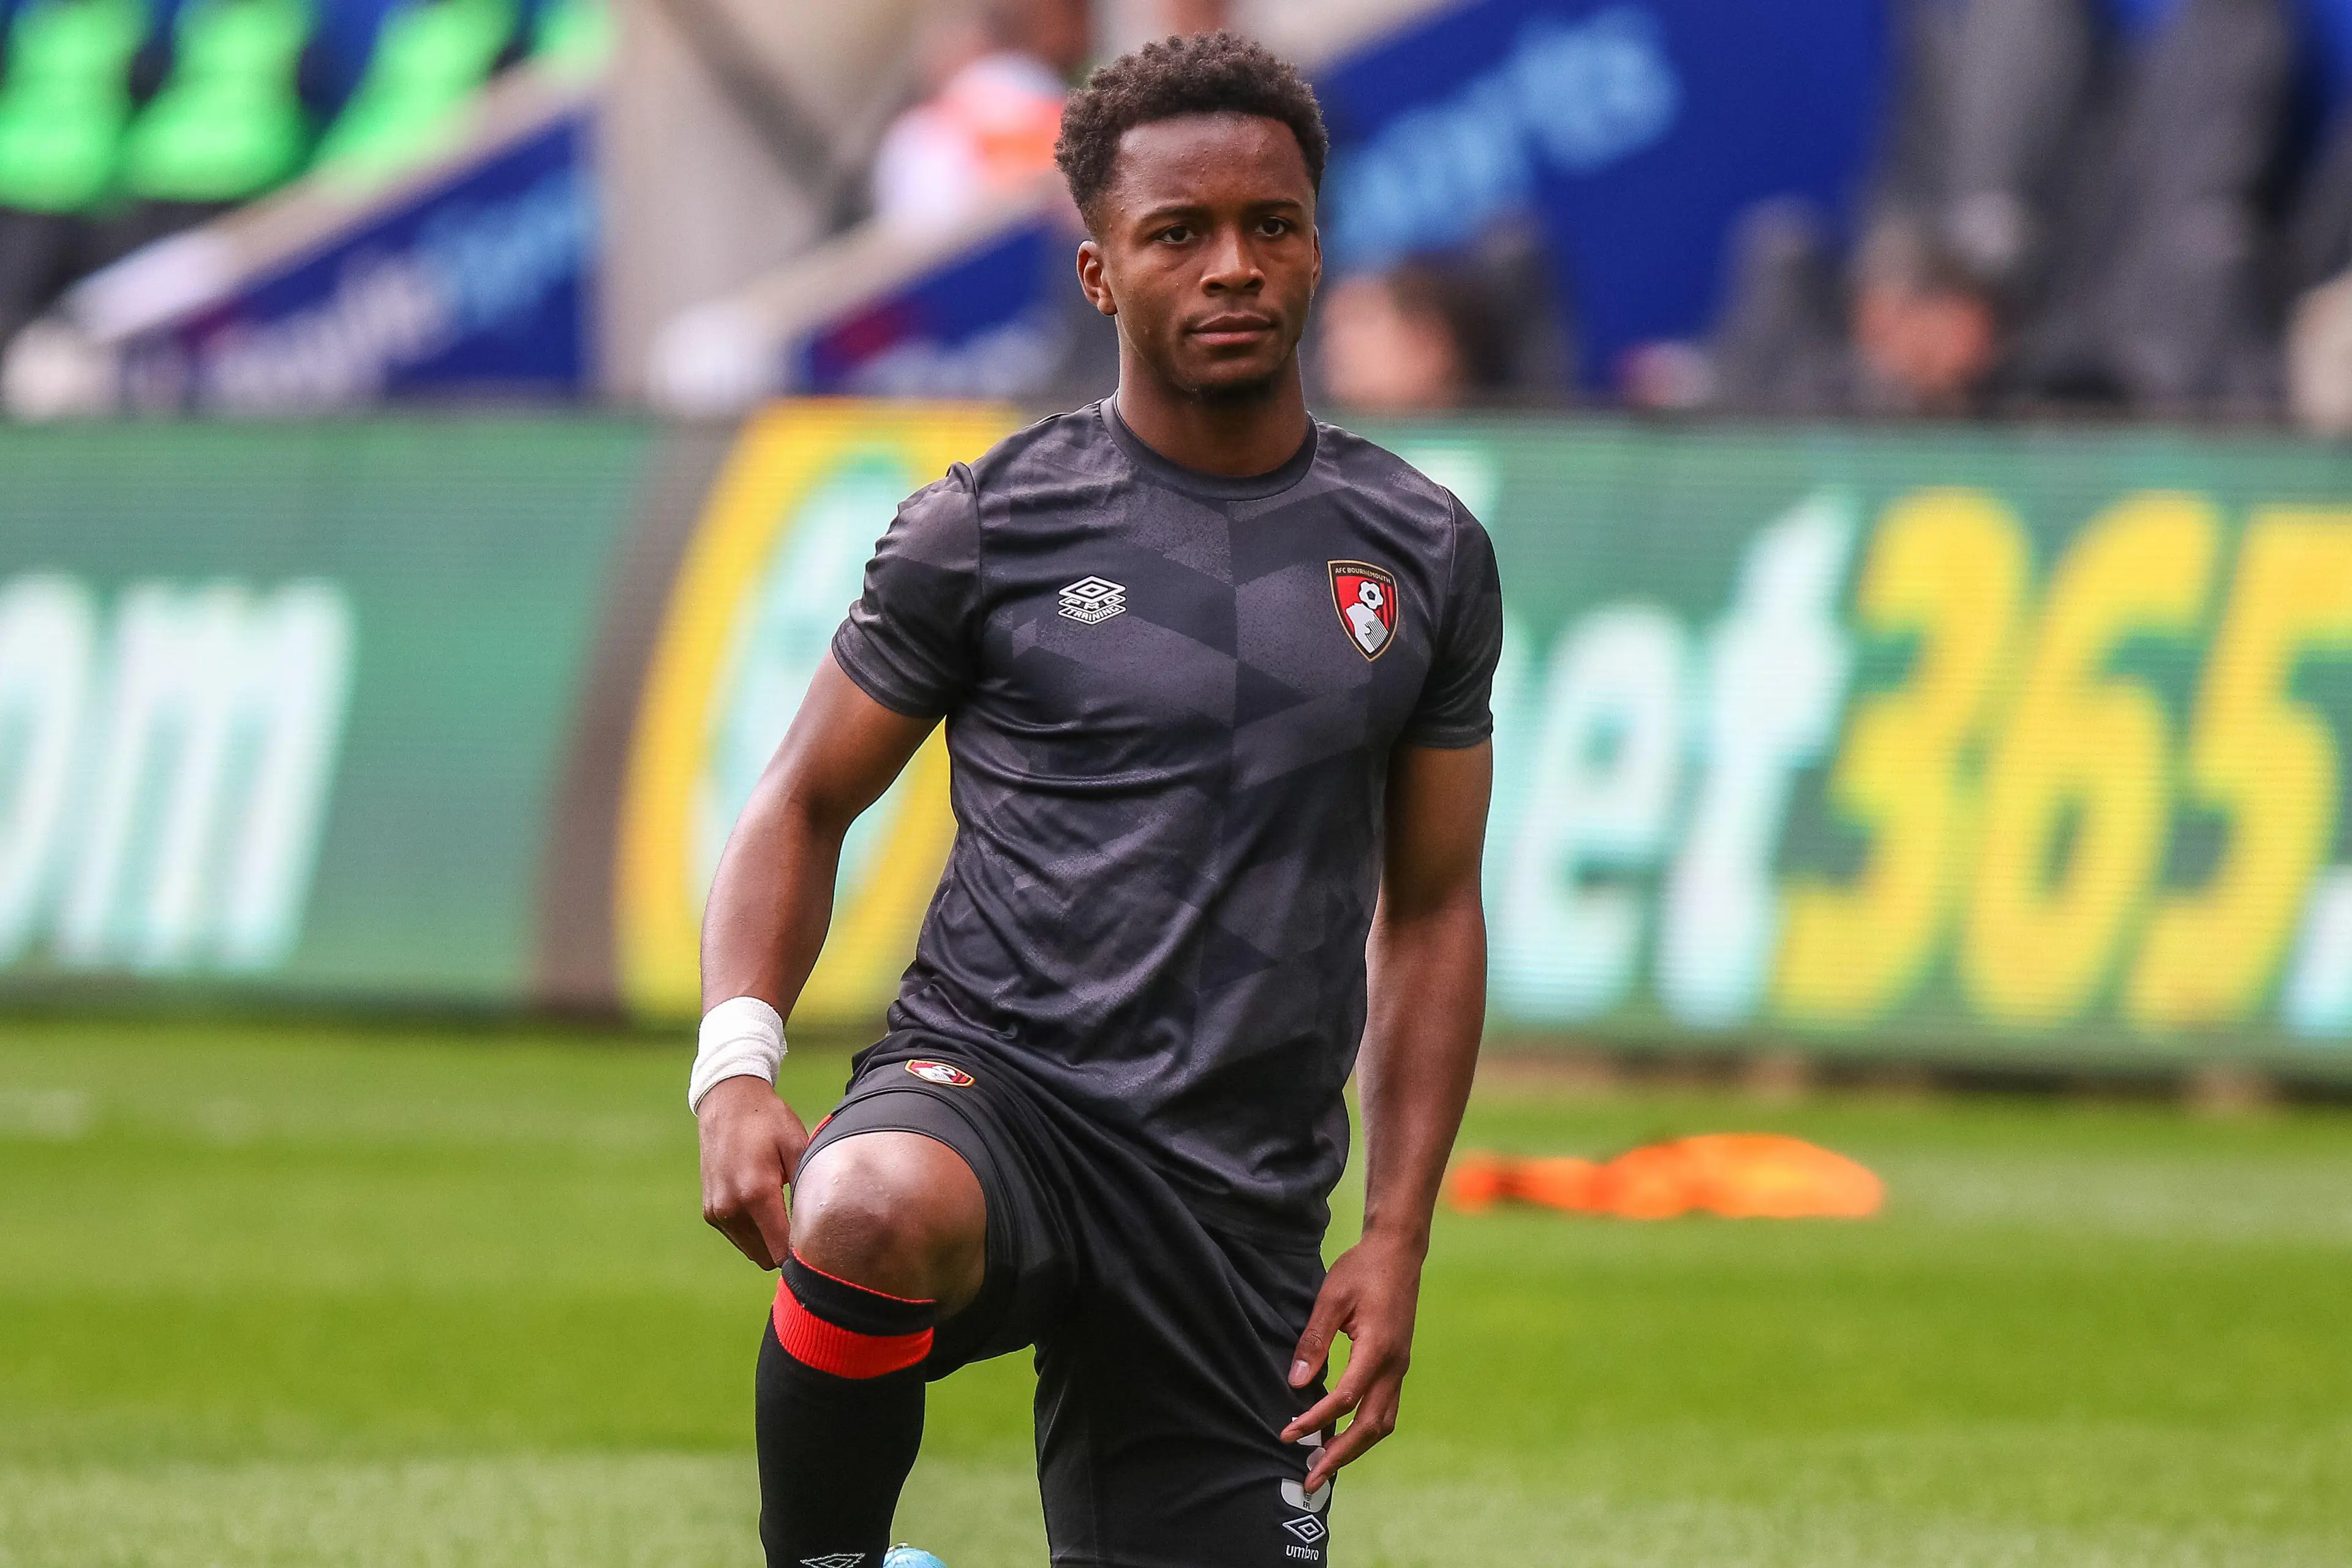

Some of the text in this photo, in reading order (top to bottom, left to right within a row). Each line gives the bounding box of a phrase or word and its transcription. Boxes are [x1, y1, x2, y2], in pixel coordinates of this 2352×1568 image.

[1347, 567, 1391, 584] BOURNEMOUTH
[1065, 594, 1121, 610] PRO
[1067, 605, 1120, 622] TRAINING
[1286, 1545, 1319, 1561] umbro
